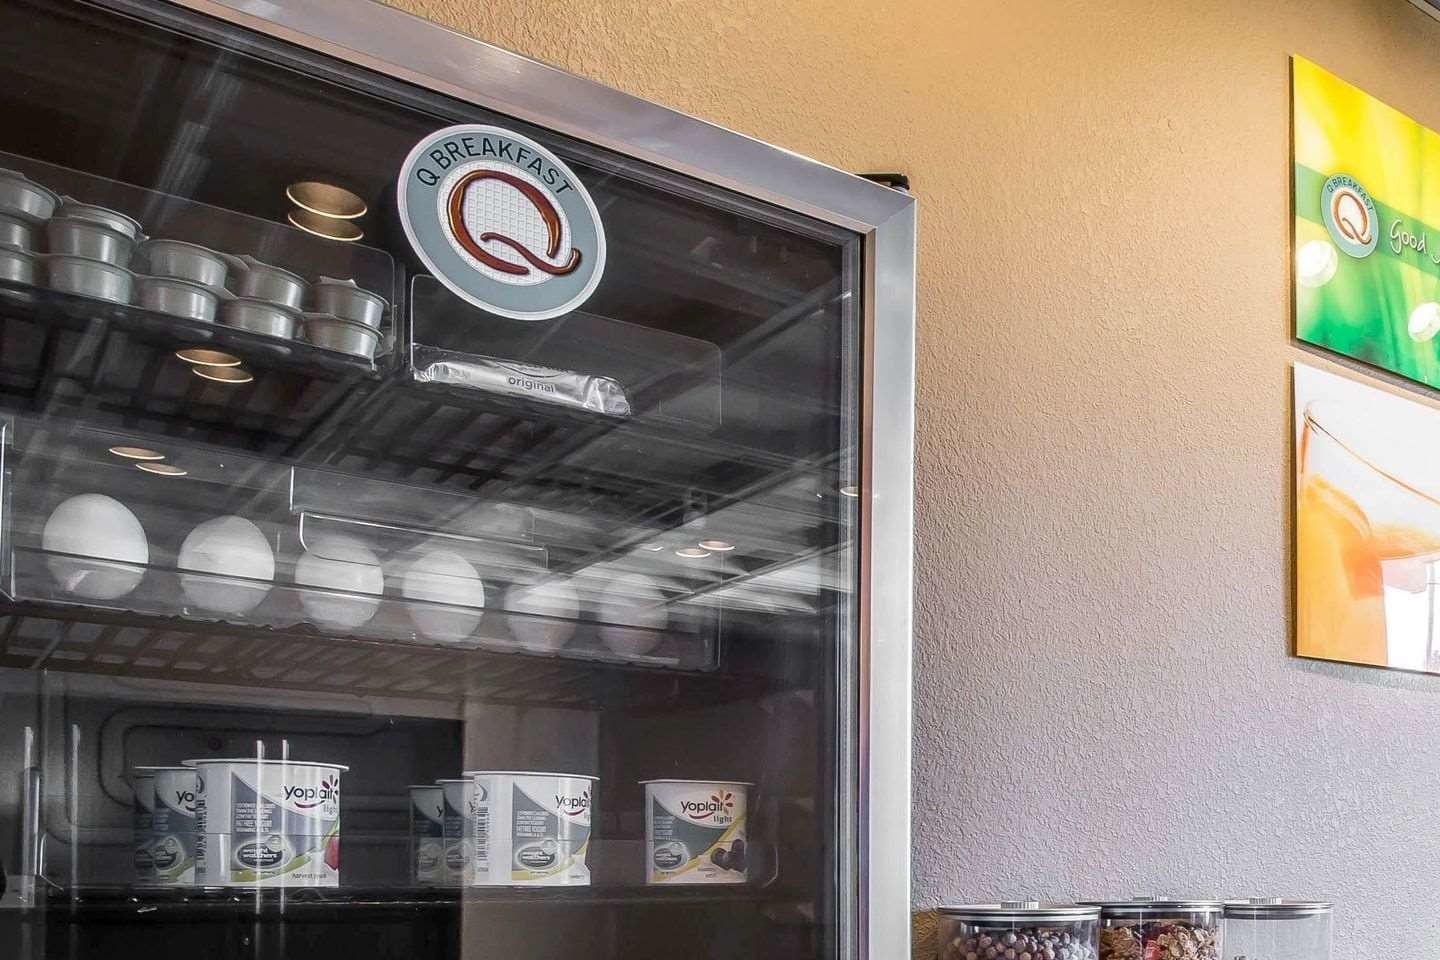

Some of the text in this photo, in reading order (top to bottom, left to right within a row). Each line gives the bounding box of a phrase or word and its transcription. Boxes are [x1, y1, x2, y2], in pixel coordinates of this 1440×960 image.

[416, 136, 574, 196] Q BREAKFAST
[1326, 176, 1374, 212] Q BREAKFAST
[446, 168, 583, 276] Q
[1332, 190, 1373, 245] Q
[1389, 218, 1428, 255] Good
[508, 376, 555, 393] original
[713, 815, 733, 824] light
